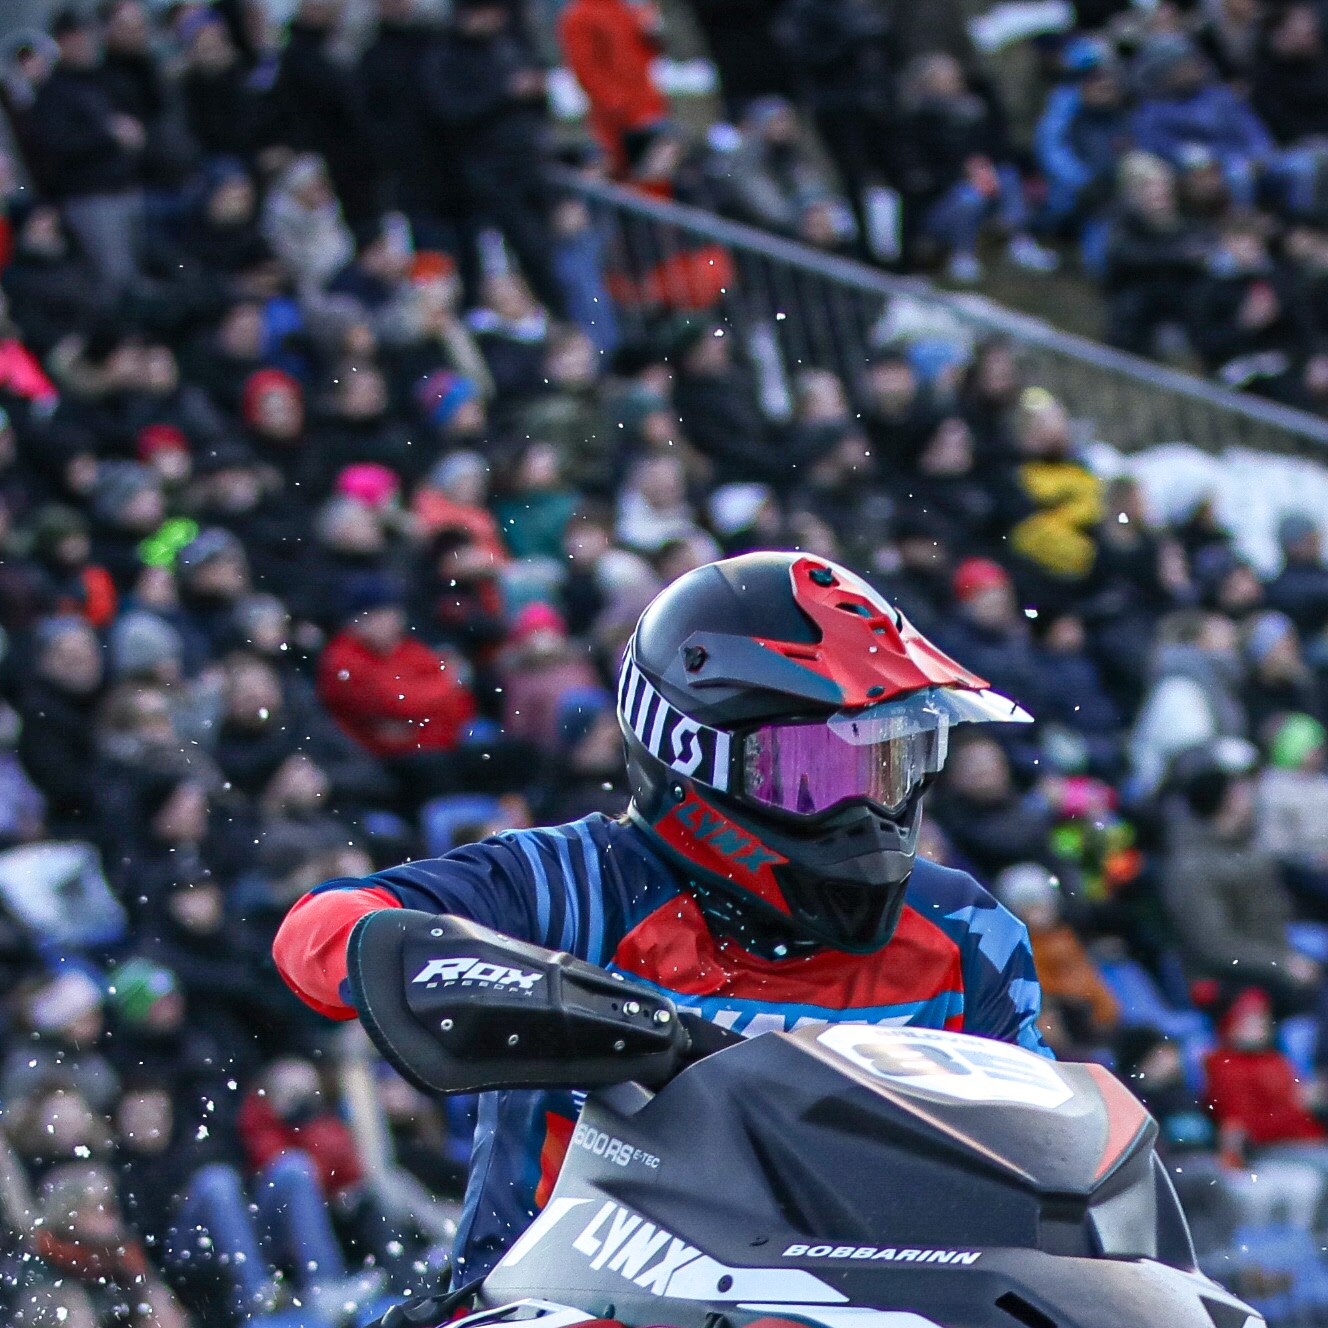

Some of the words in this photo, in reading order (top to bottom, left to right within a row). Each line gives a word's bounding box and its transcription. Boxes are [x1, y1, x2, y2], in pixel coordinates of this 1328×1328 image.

[676, 801, 779, 874] LYNX
[411, 957, 544, 989] ROX
[572, 1199, 703, 1297] LYNX
[781, 1244, 983, 1265] BOBBARINN
